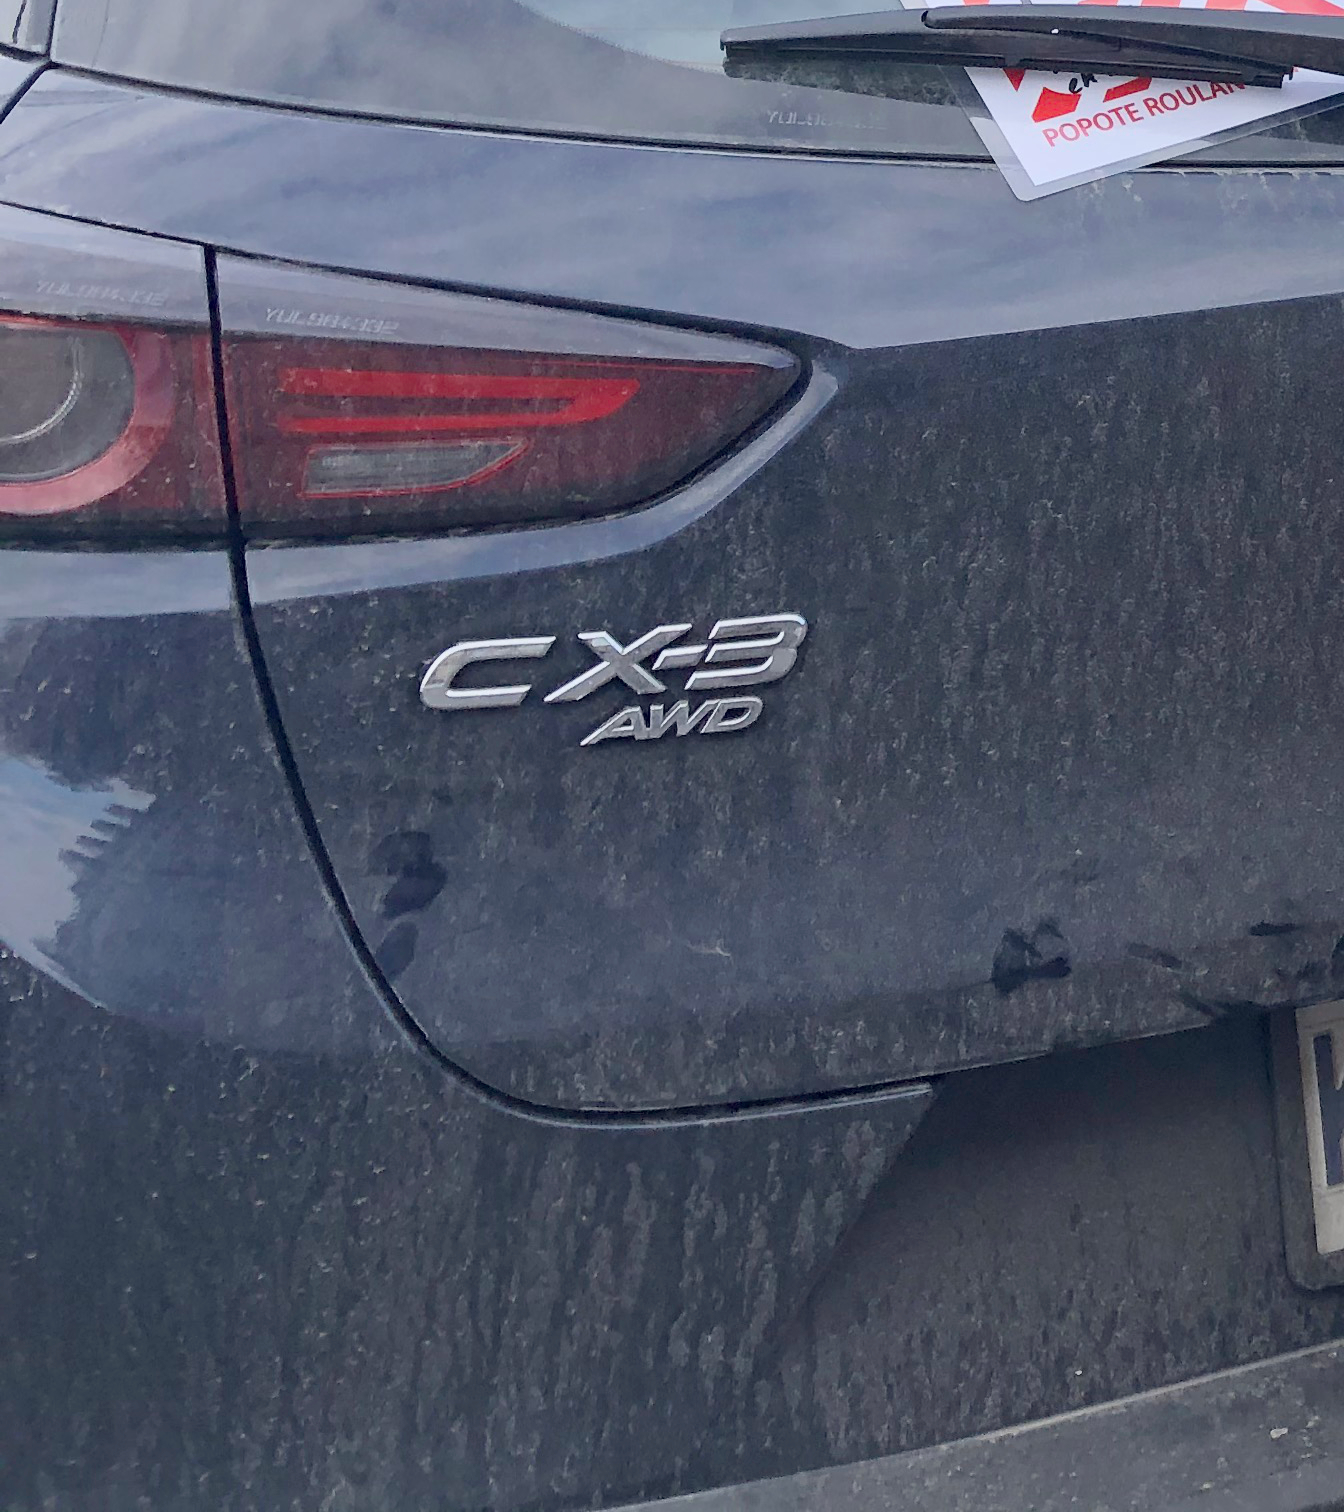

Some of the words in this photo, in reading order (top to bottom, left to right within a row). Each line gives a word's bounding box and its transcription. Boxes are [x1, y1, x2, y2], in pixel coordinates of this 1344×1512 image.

[1042, 102, 1144, 147] POPOTE
[419, 611, 808, 711] CX-3
[580, 695, 764, 747] AWD
